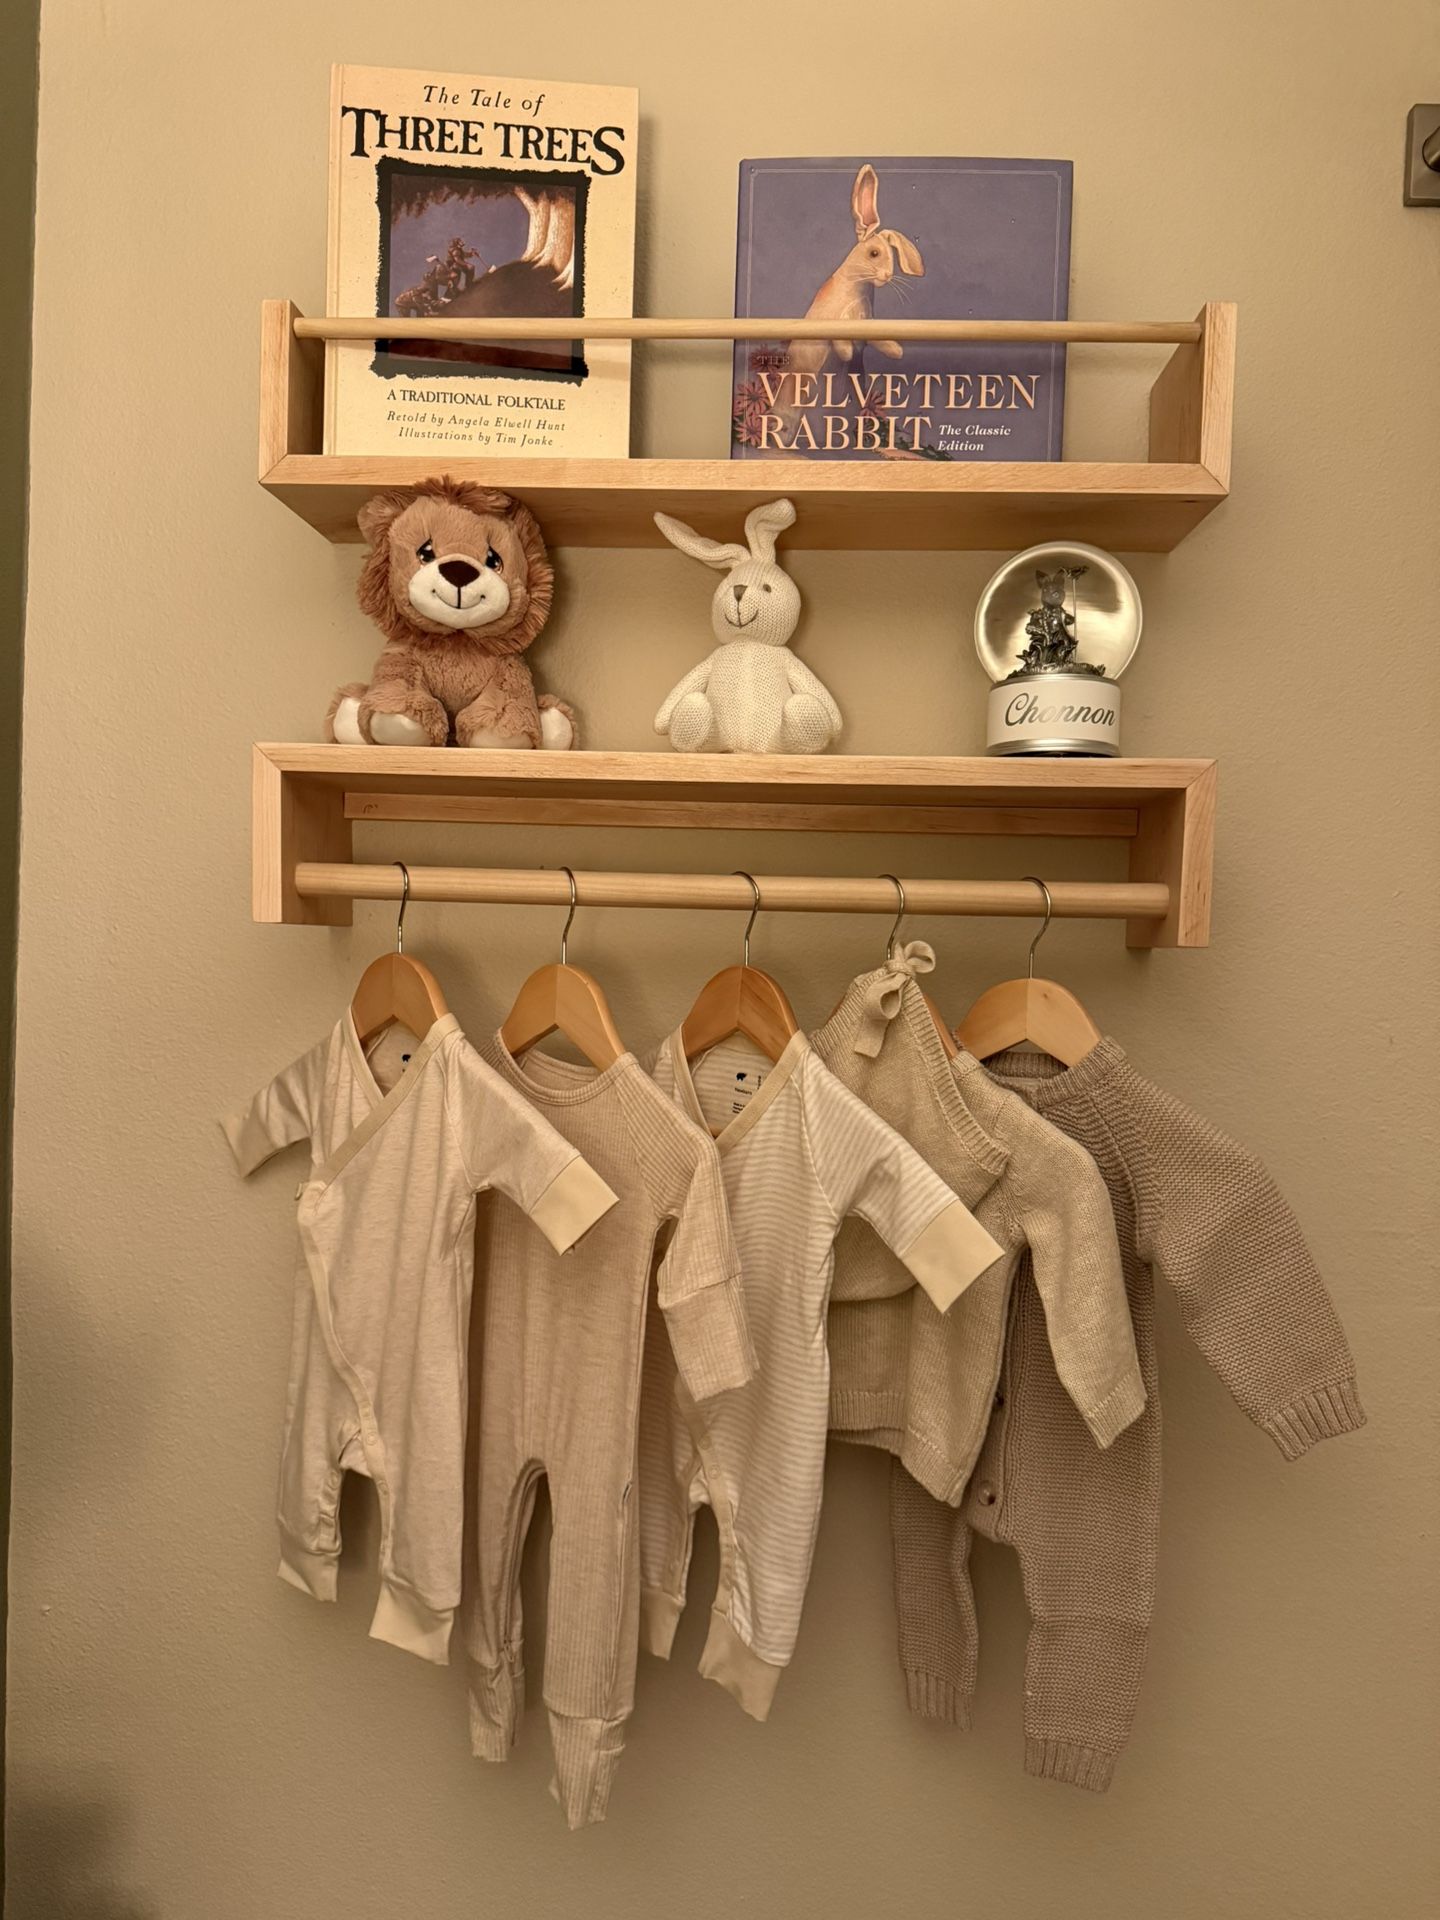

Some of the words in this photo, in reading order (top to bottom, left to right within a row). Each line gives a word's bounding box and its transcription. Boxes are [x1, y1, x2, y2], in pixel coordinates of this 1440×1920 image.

[423, 85, 460, 105] The
[470, 89, 512, 109] Tale
[521, 94, 546, 117] of
[341, 105, 485, 158] THREE
[493, 122, 625, 175] TREES
[756, 355, 790, 365] THE
[387, 389, 397, 401] A
[400, 389, 492, 406] TRADITIONAL
[497, 395, 566, 410] FOLKTALE
[757, 373, 1040, 410] VELVETEEN
[387, 411, 427, 423] Retold
[431, 413, 444, 426] by
[448, 414, 490, 429] Angela
[494, 417, 532, 429] Elwell
[535, 419, 566, 431] Hunt
[938, 424, 962, 436] The
[964, 424, 1011, 437] Classic
[398, 426, 473, 441] Illustrations
[478, 432, 491, 445] by
[495, 432, 517, 444] Tim
[520, 434, 554, 448] Jonke
[757, 415, 932, 451] RABBIT
[938, 440, 984, 452] Edition
